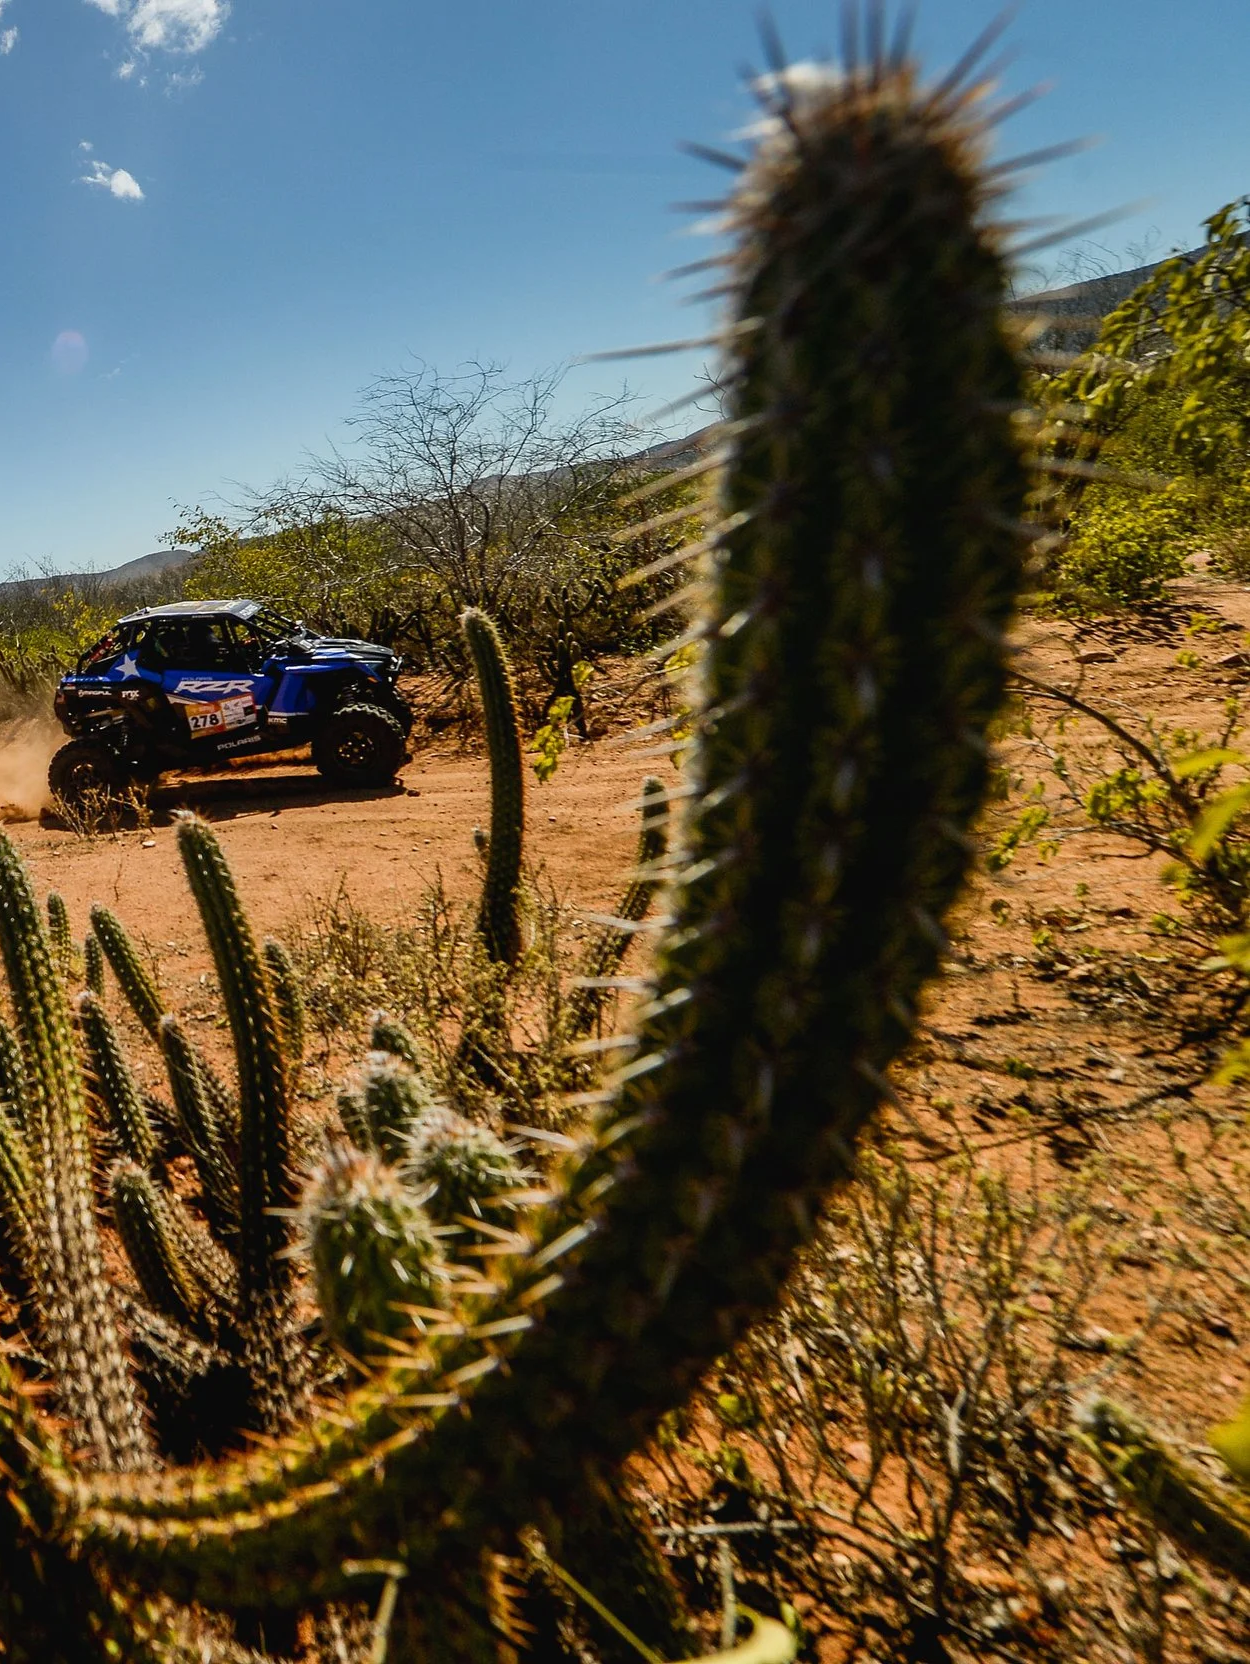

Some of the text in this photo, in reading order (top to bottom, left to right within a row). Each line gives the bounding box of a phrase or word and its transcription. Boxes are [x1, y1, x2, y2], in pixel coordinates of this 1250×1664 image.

[175, 680, 254, 694] RZR
[191, 714, 219, 728] 278
[216, 735, 261, 750] POLARIS
